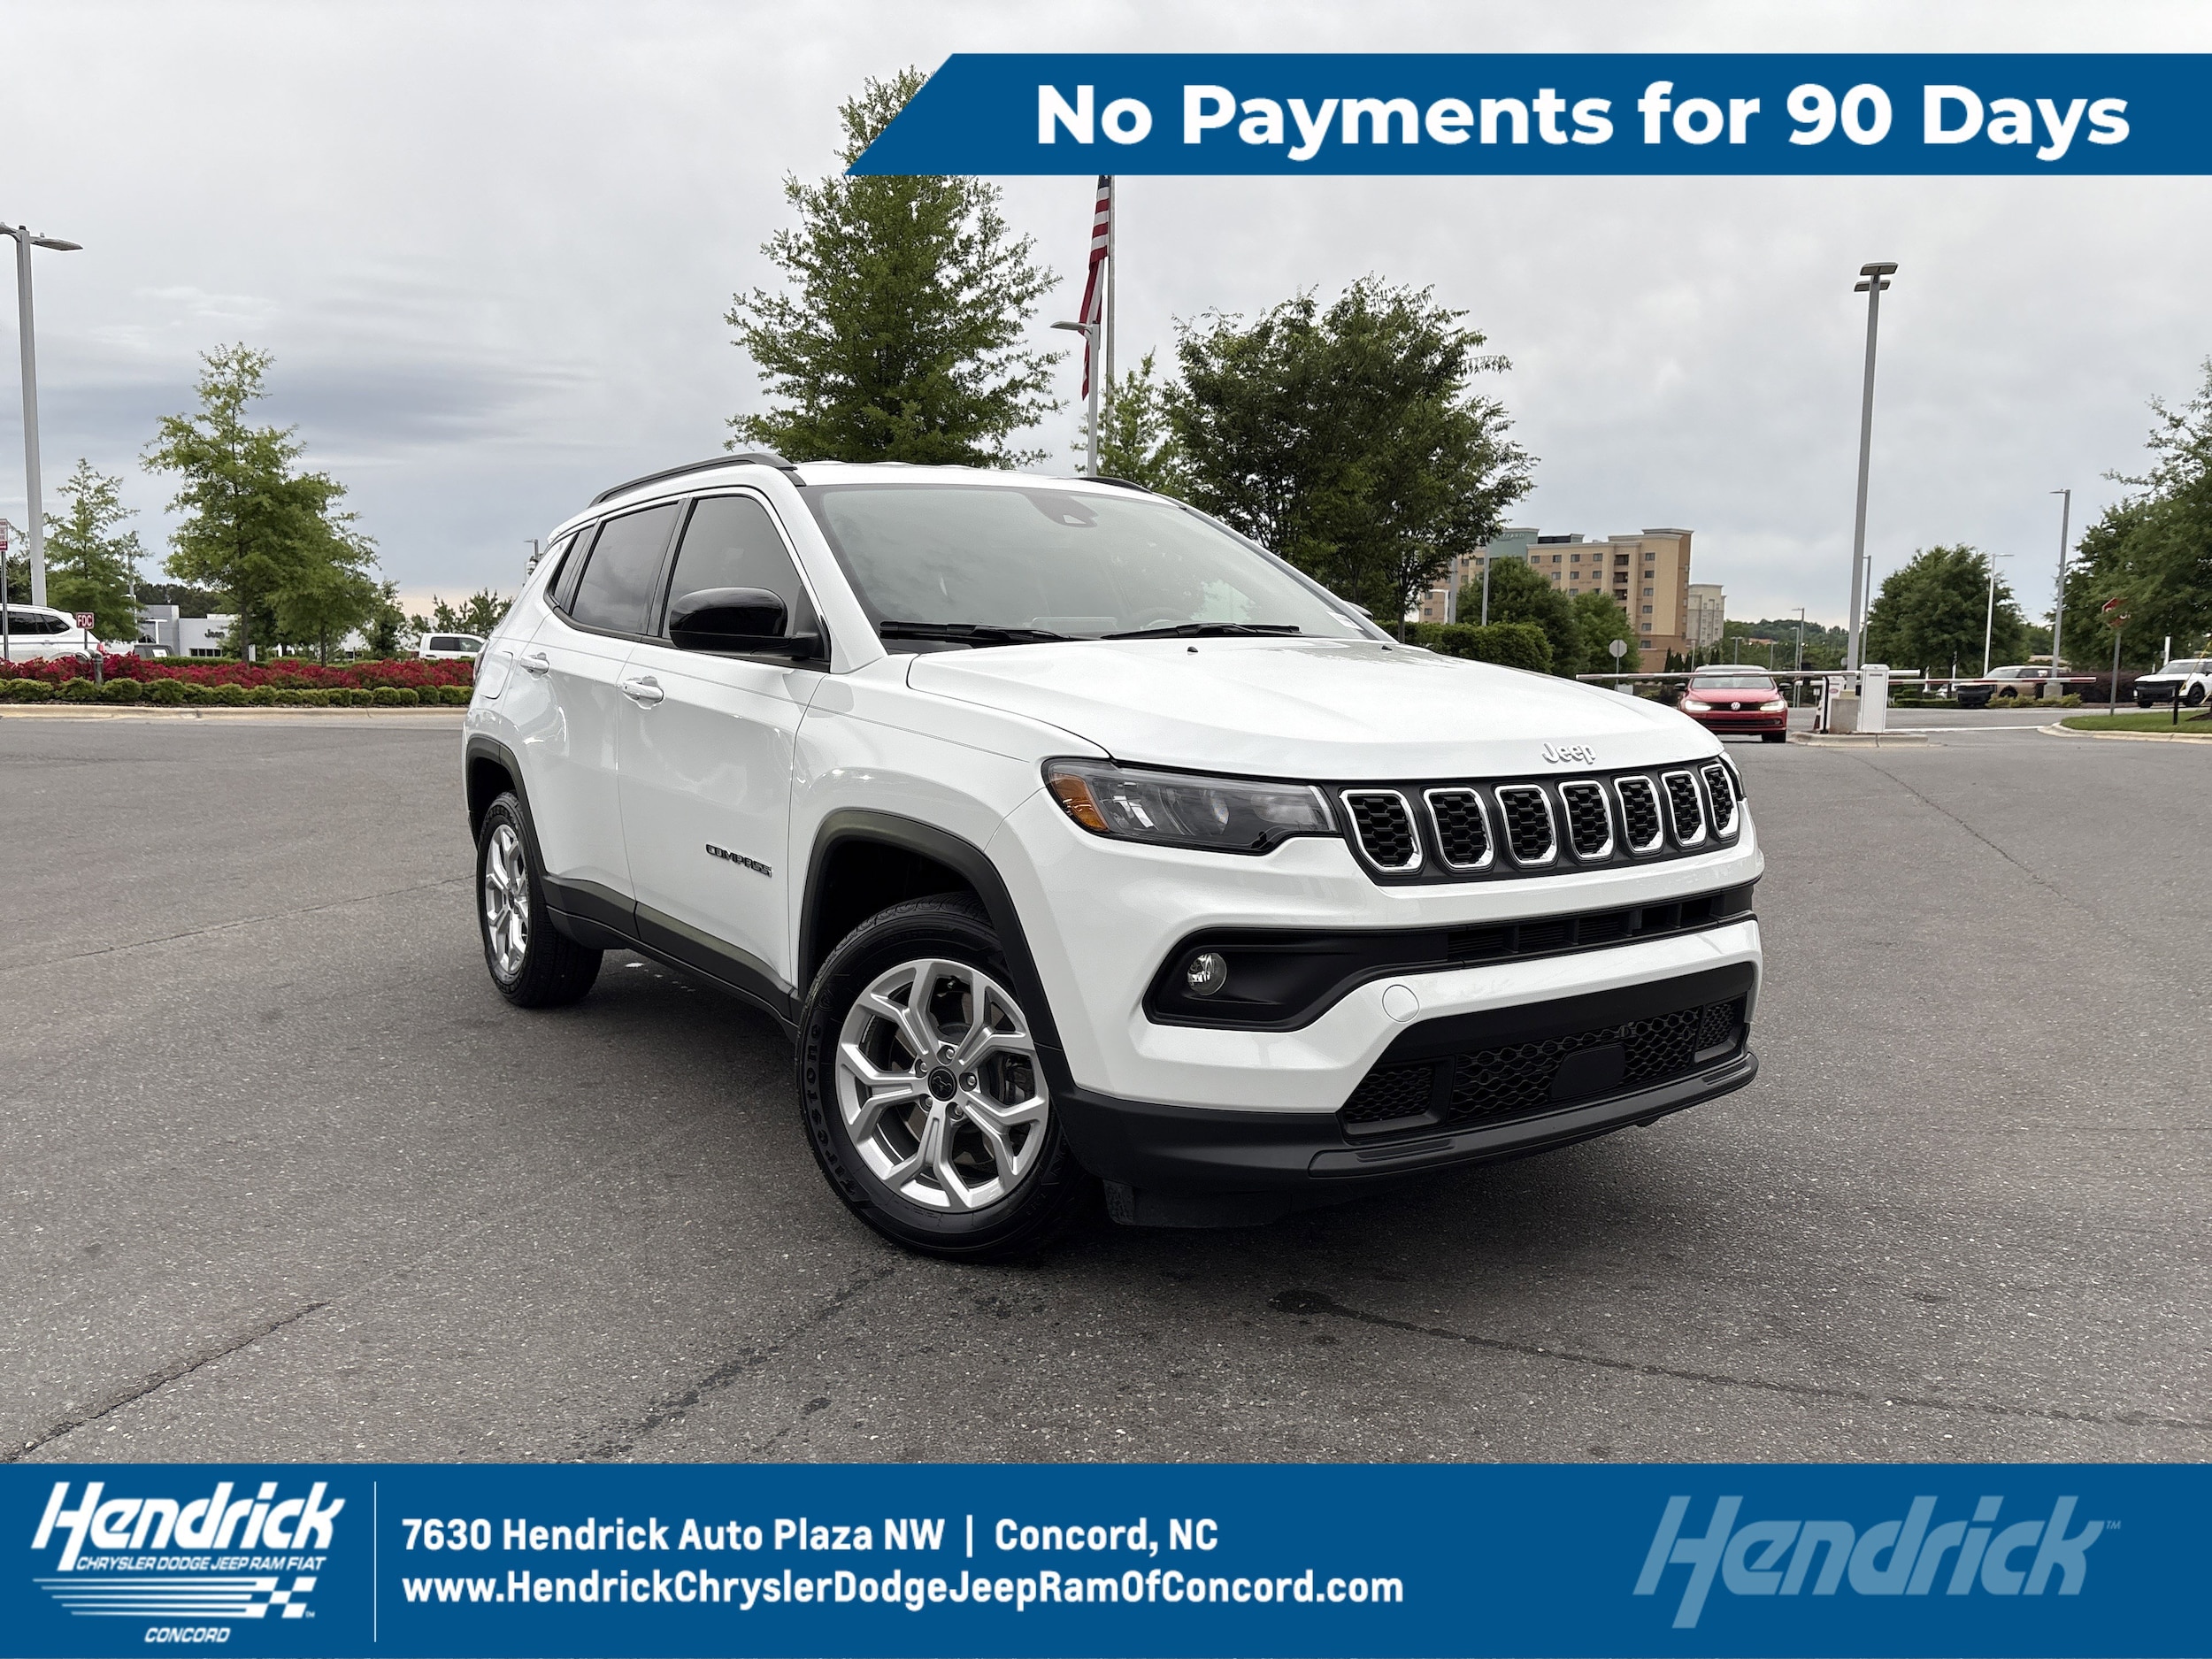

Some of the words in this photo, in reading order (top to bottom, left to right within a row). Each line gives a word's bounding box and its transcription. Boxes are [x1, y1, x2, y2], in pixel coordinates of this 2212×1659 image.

[77, 614, 93, 626] FDC
[1541, 741, 1596, 764] Jeep
[705, 843, 773, 878] COMPASS
